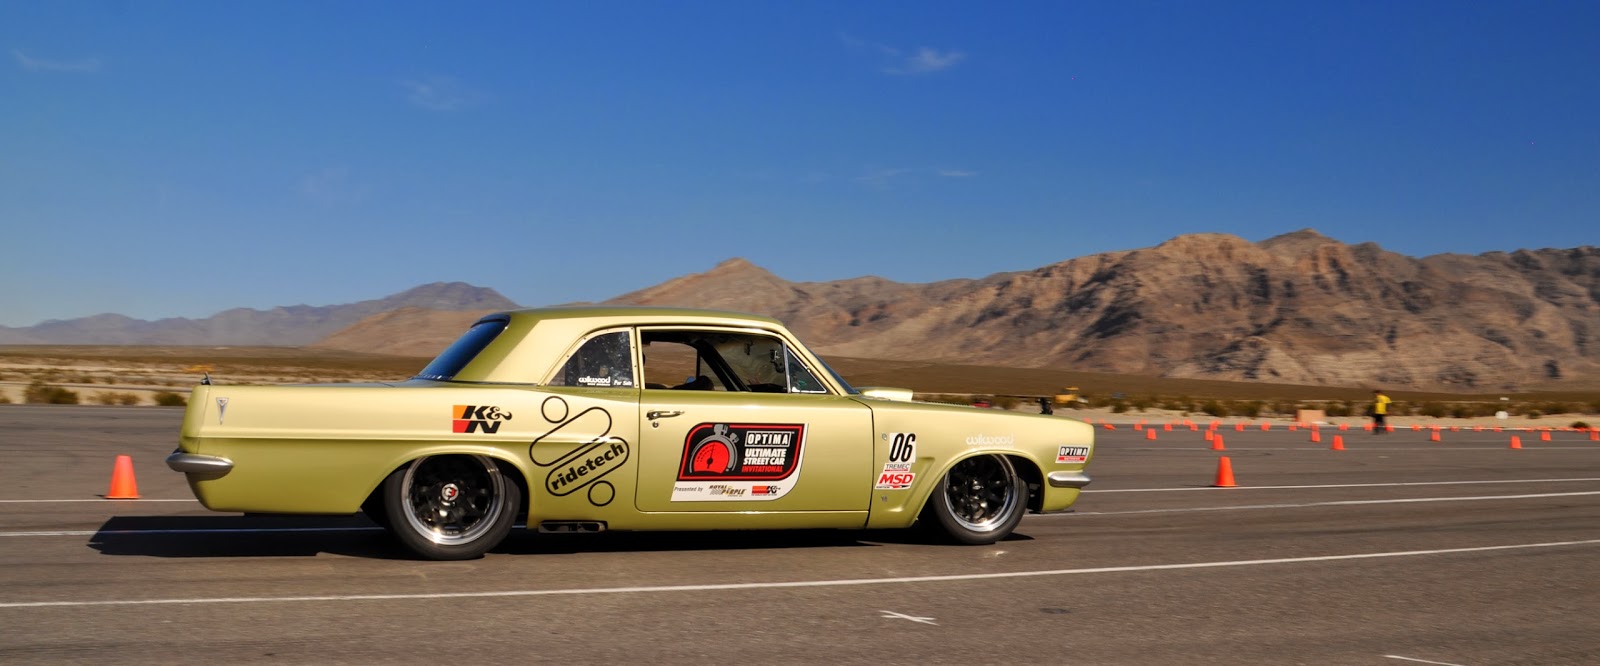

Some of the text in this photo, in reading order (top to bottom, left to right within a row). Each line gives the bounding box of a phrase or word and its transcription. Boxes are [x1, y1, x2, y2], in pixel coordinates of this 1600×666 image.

[748, 434, 788, 444] OPTIMA
[889, 433, 916, 462] 06
[1060, 447, 1088, 456] OPTIMA
[745, 449, 786, 457] ULTIMATE
[551, 442, 625, 491] ridetech
[879, 474, 913, 484] MSD
